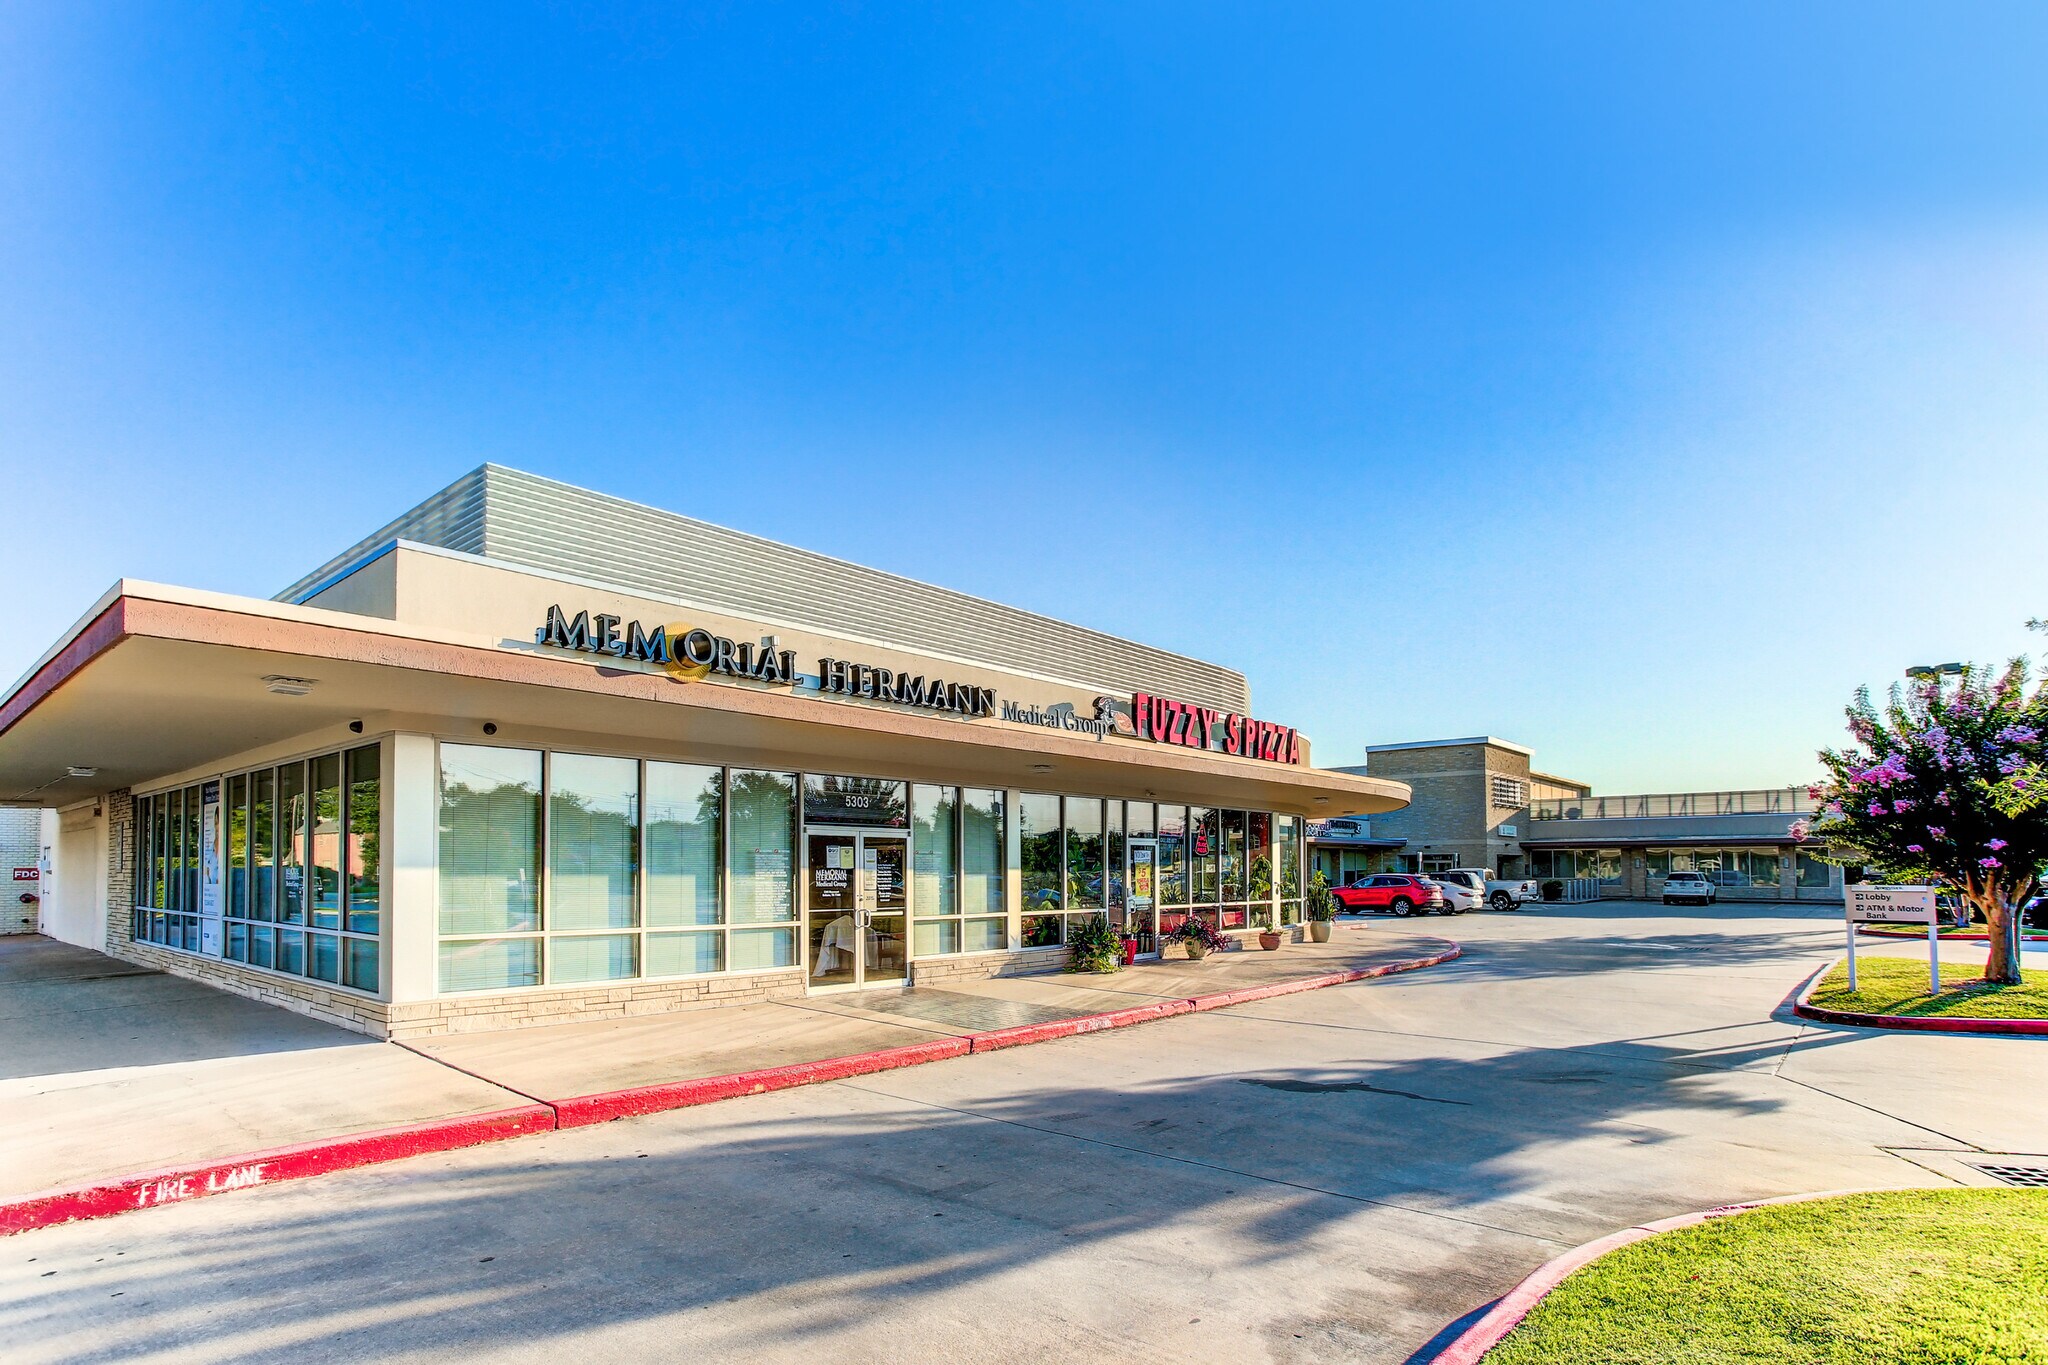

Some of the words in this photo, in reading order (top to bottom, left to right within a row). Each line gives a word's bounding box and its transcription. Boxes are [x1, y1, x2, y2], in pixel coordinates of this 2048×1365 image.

[542, 604, 804, 685] MEMORIAL
[818, 658, 997, 717] HERMANN
[1003, 700, 1059, 728] Medical
[1064, 710, 1108, 741] Group
[1242, 718, 1301, 765] PIZZA
[845, 795, 869, 808] 5303
[14, 870, 39, 878] FDC
[833, 881, 848, 889] Group
[1865, 893, 1892, 901] Lobby
[1866, 904, 1886, 912] ATM
[136, 1176, 195, 1206] FIRE
[206, 1163, 270, 1190] LANE
